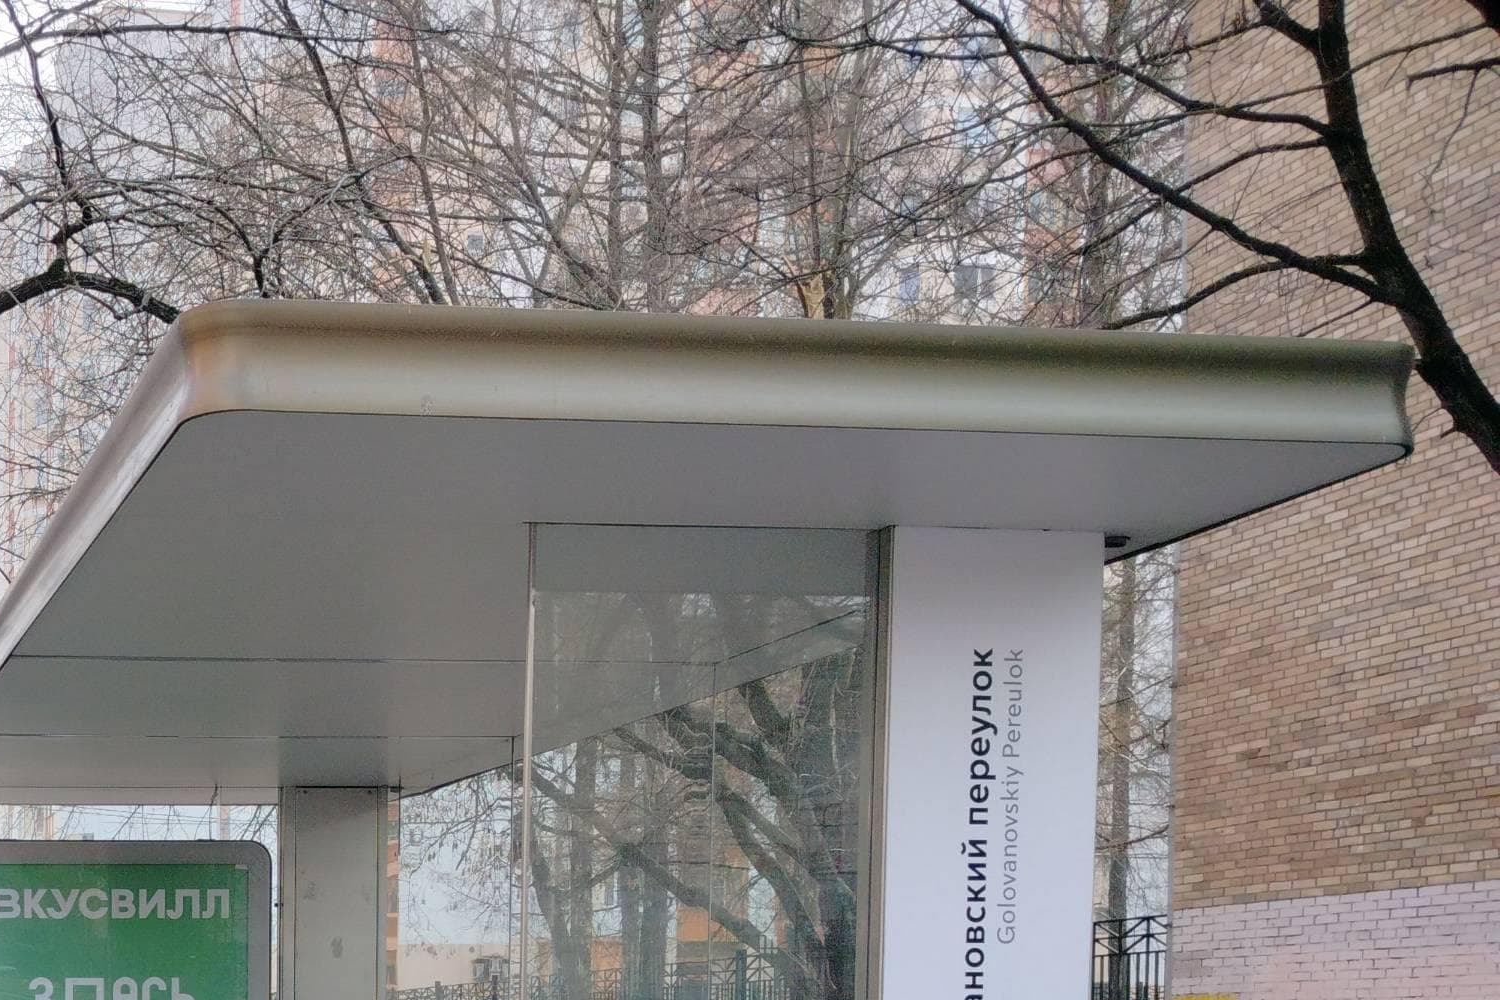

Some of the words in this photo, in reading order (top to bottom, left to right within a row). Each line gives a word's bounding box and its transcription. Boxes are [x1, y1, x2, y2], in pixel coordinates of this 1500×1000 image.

[969, 648, 998, 825] переулок
[1002, 649, 1024, 757] Pereulok
[997, 766, 1024, 944] Golovanovskiy
